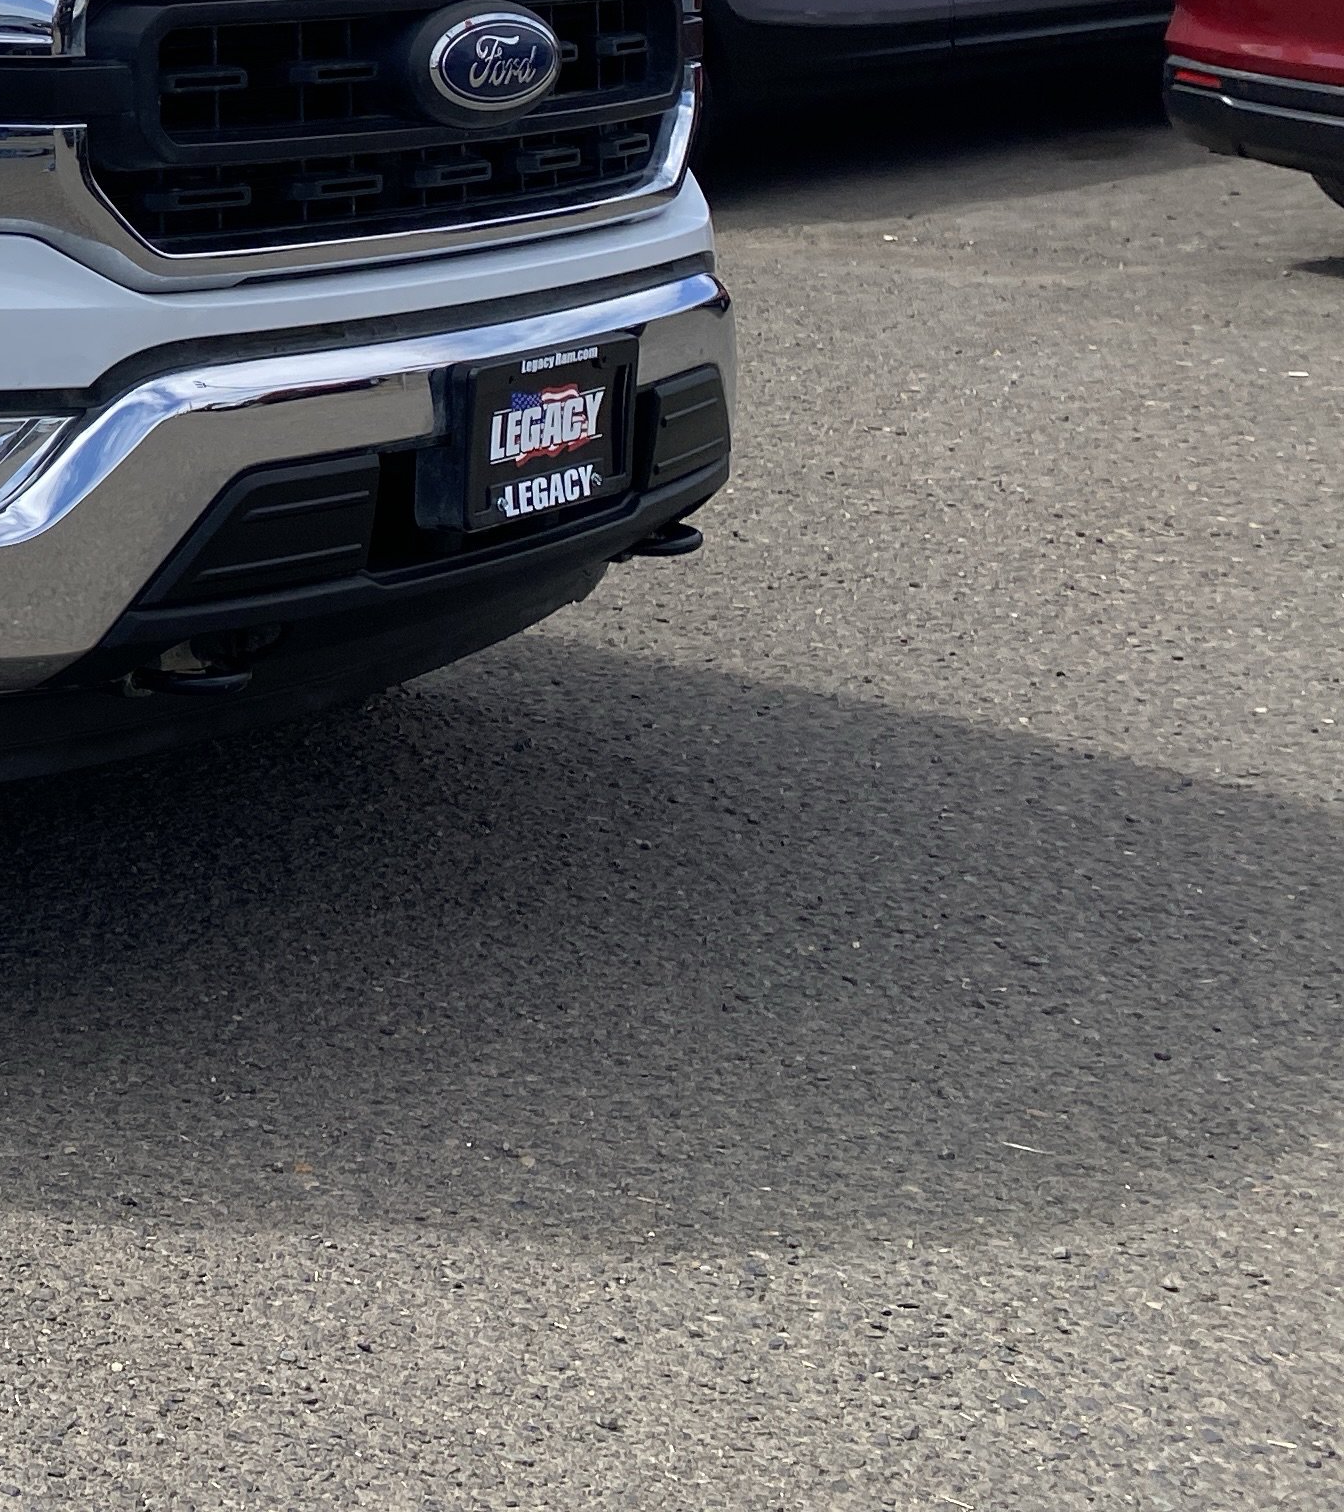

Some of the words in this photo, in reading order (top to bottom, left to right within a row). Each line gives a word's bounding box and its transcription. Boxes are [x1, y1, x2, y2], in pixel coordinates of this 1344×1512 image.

[469, 35, 537, 88] Ford
[490, 390, 605, 460] LEGACY
[504, 464, 594, 517] LEGACY
